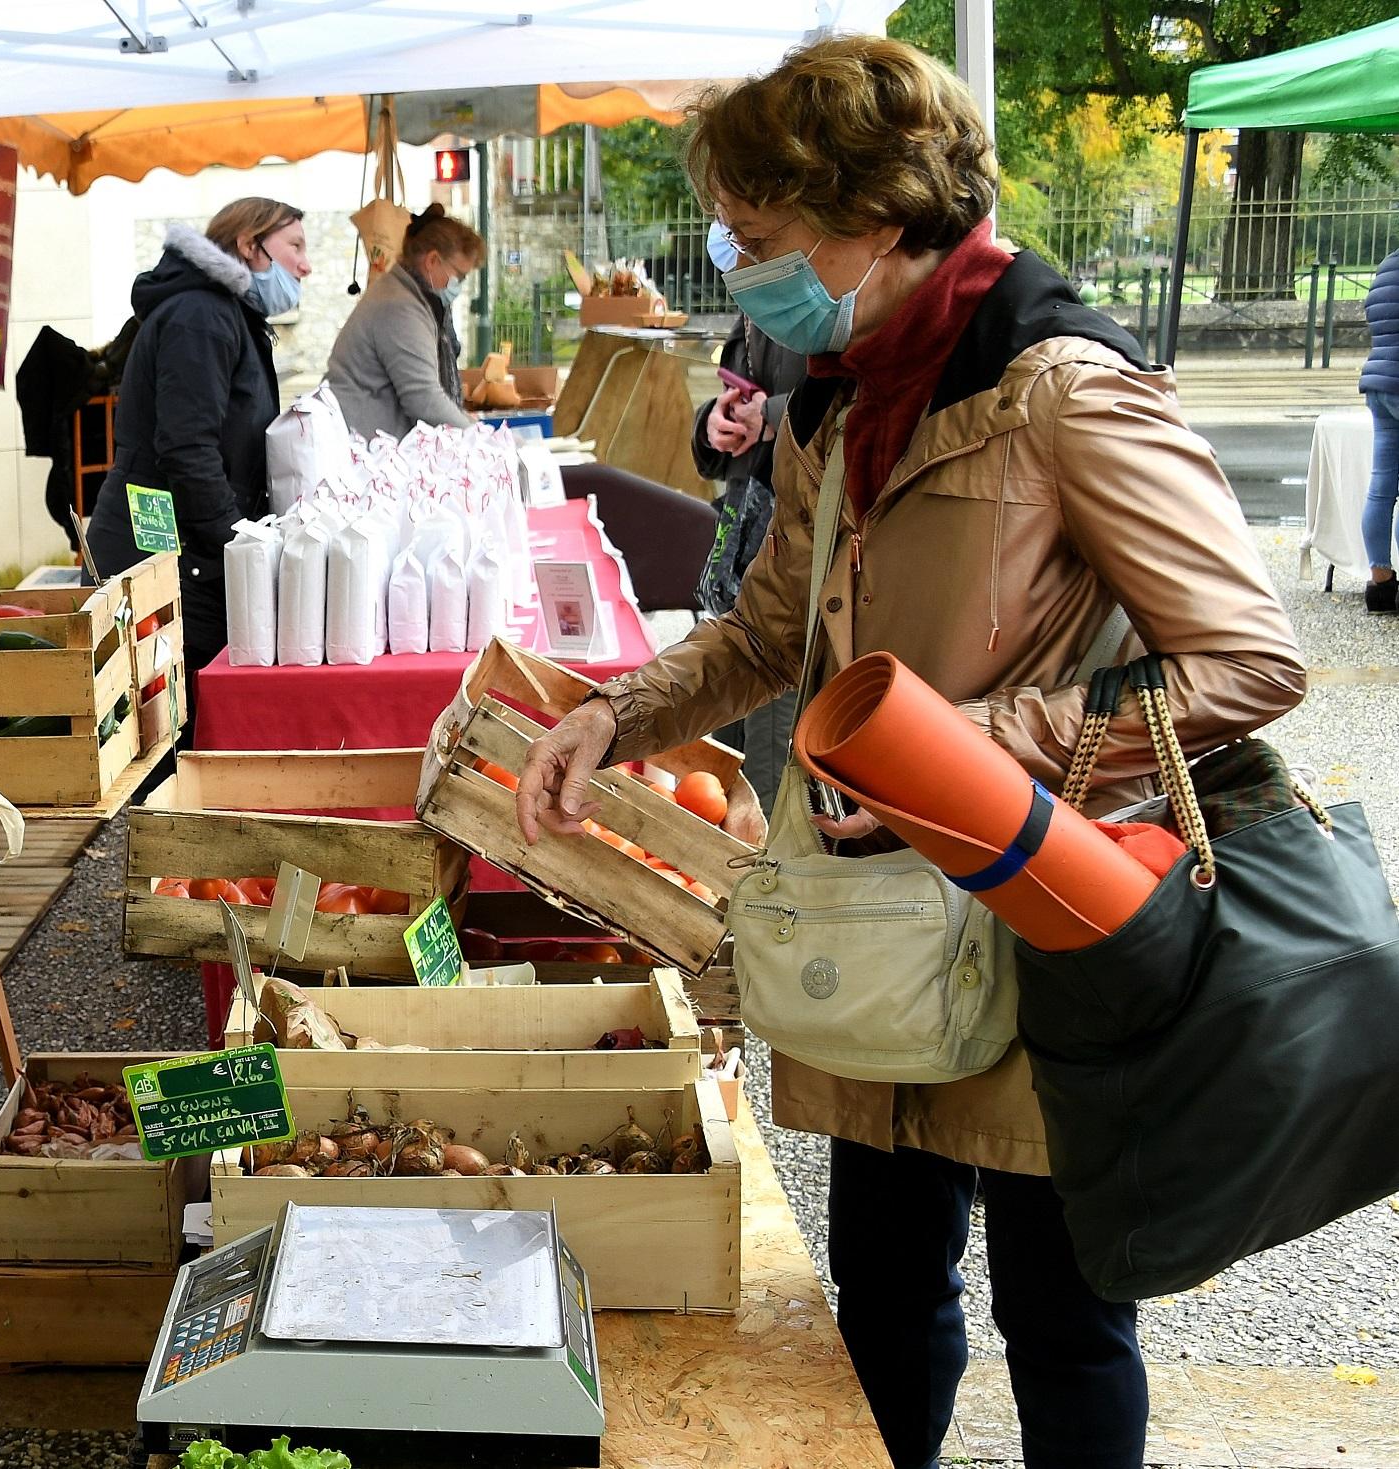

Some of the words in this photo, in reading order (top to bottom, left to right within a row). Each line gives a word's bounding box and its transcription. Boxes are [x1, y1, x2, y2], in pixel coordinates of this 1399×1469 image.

[228, 1044, 265, 1060] planète
[134, 1078, 154, 1094] AB
[160, 1096, 233, 1115] OIGNONS
[169, 1108, 242, 1128] JAUNES
[237, 1118, 262, 1135] VAL
